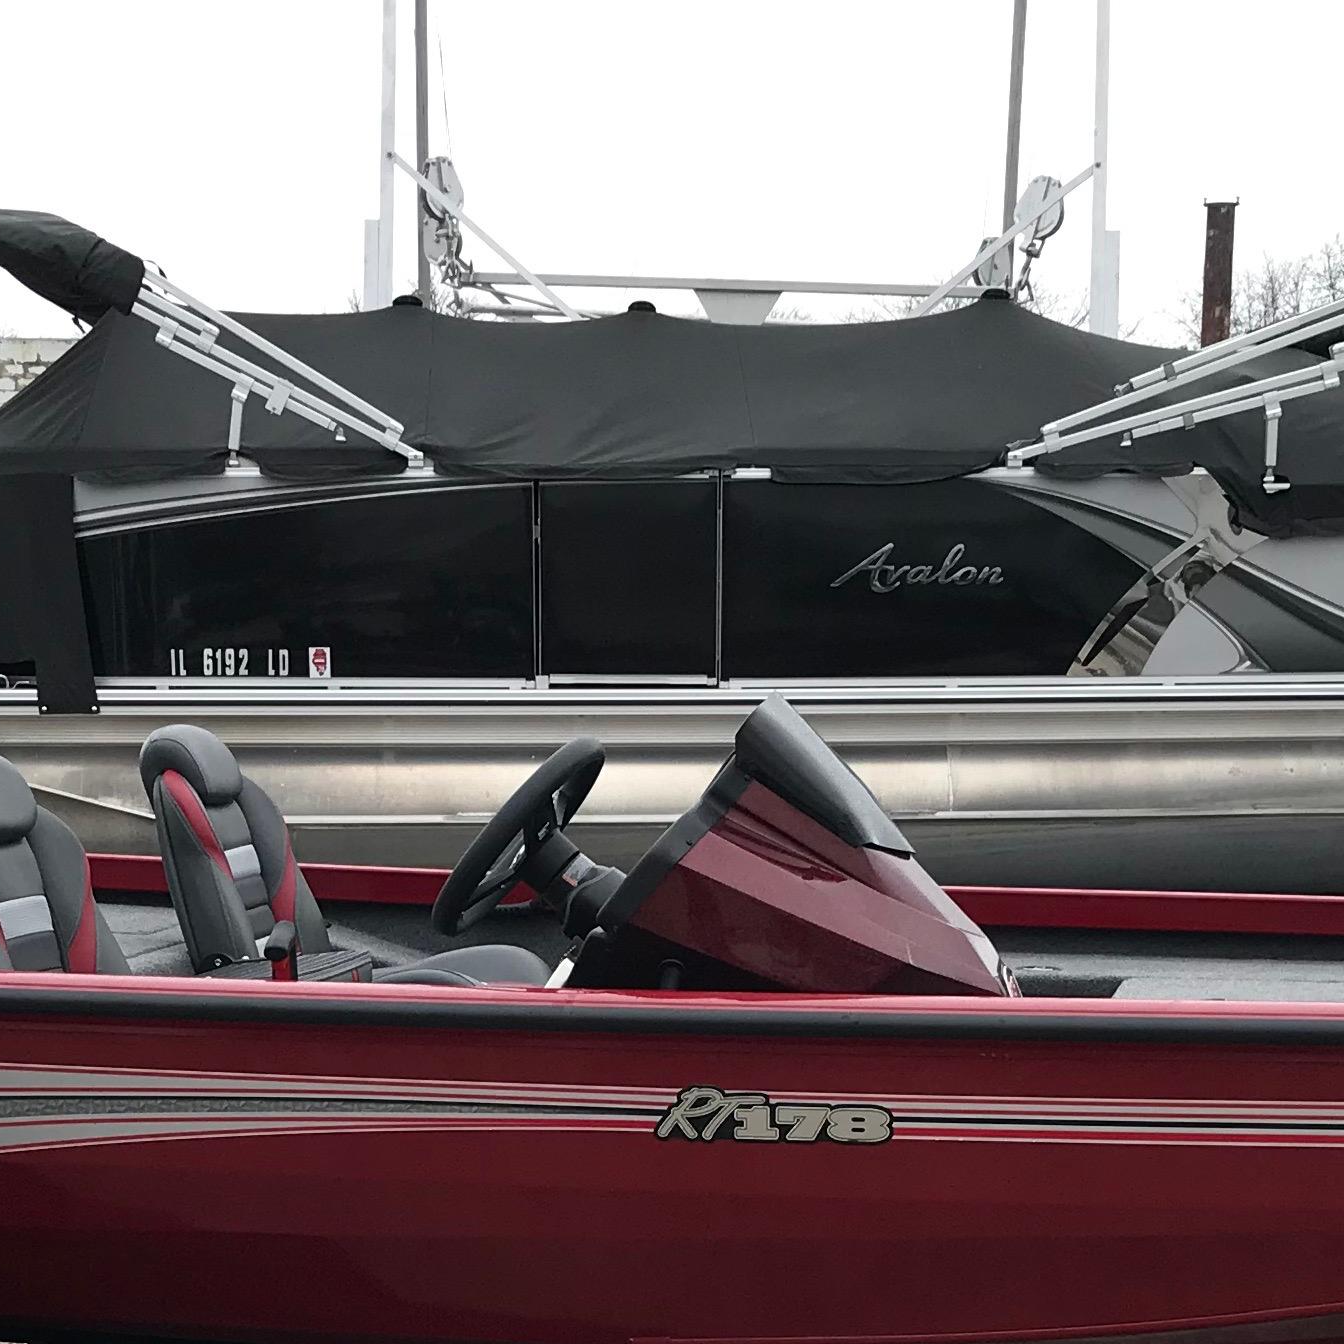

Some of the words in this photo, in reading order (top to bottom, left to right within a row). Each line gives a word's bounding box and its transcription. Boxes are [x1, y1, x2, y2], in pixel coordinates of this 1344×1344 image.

[830, 543, 1004, 593] Avalon
[170, 648, 187, 676] IL
[203, 648, 249, 676] 6192
[268, 648, 289, 676] LD
